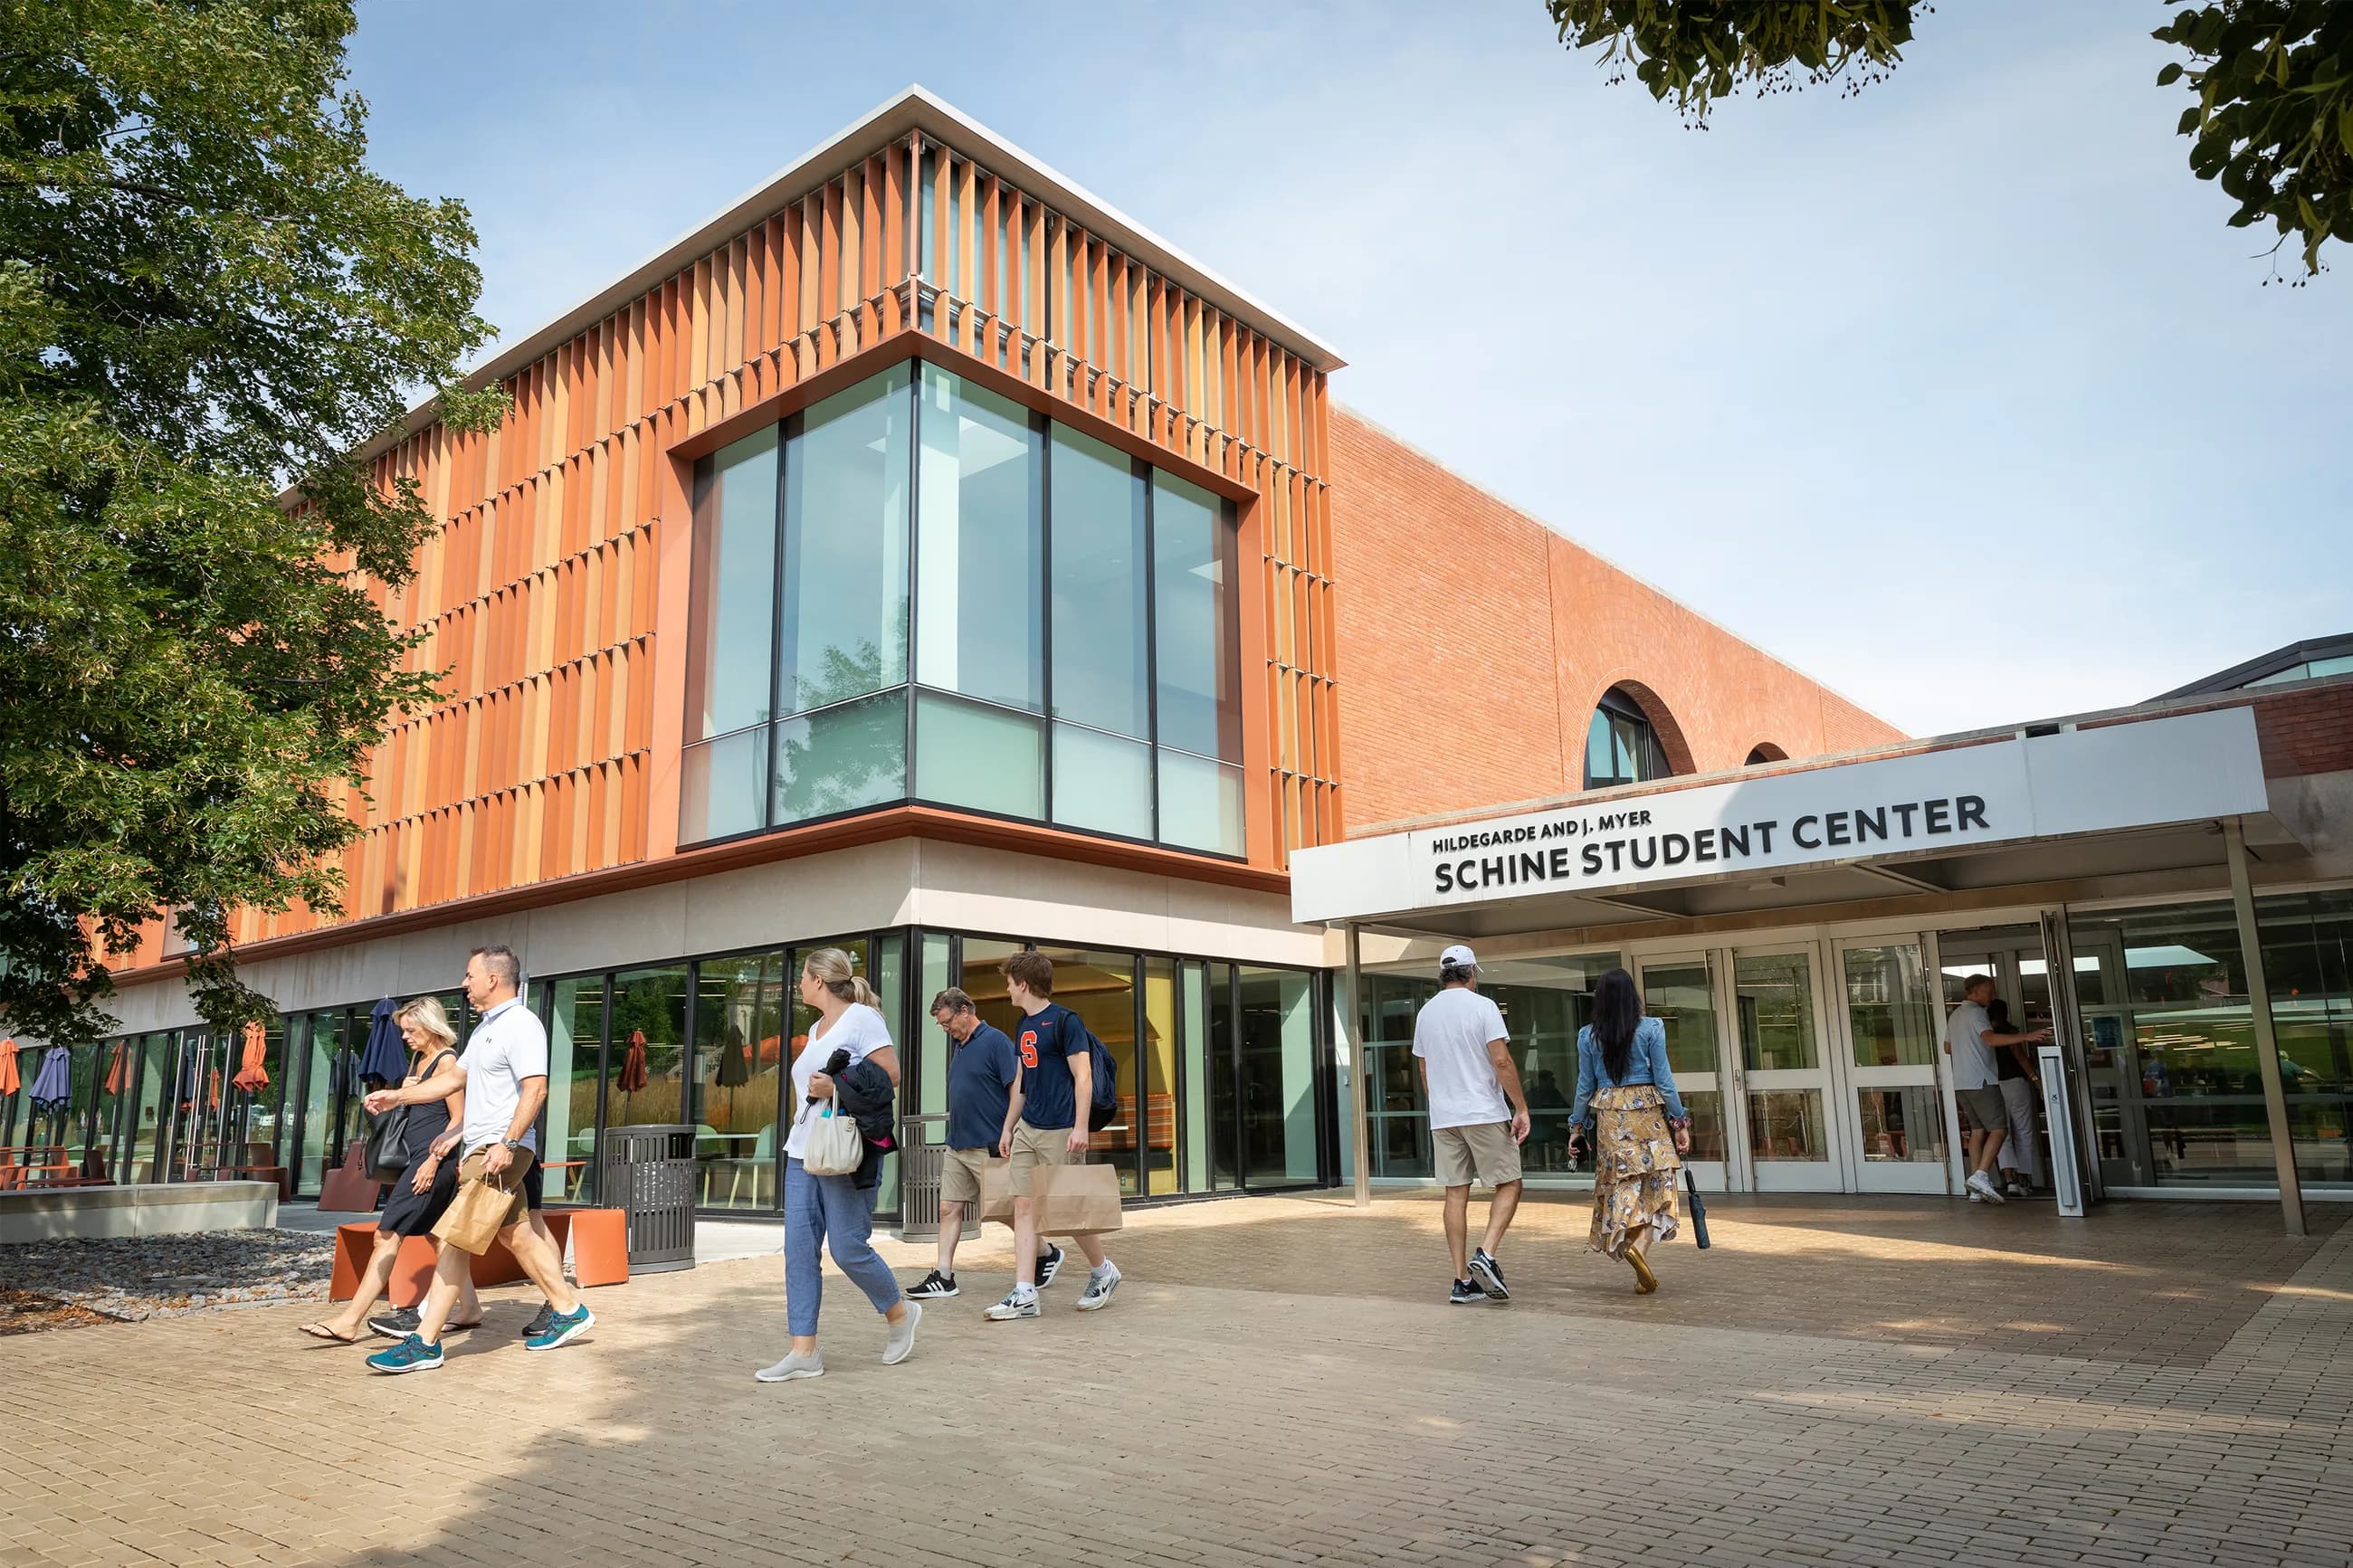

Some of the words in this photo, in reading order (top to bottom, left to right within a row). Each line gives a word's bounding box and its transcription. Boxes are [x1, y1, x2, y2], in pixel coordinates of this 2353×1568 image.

[1433, 826, 1537, 854] HILDEGARDE
[1540, 820, 1578, 839] AND
[1582, 819, 1595, 837] J.
[1599, 810, 1653, 831] MYER
[1435, 848, 1570, 893] SCHINE
[1582, 821, 1778, 875] STUDENT
[1792, 794, 1990, 849] CENTER
[1020, 1030, 1039, 1069] S
